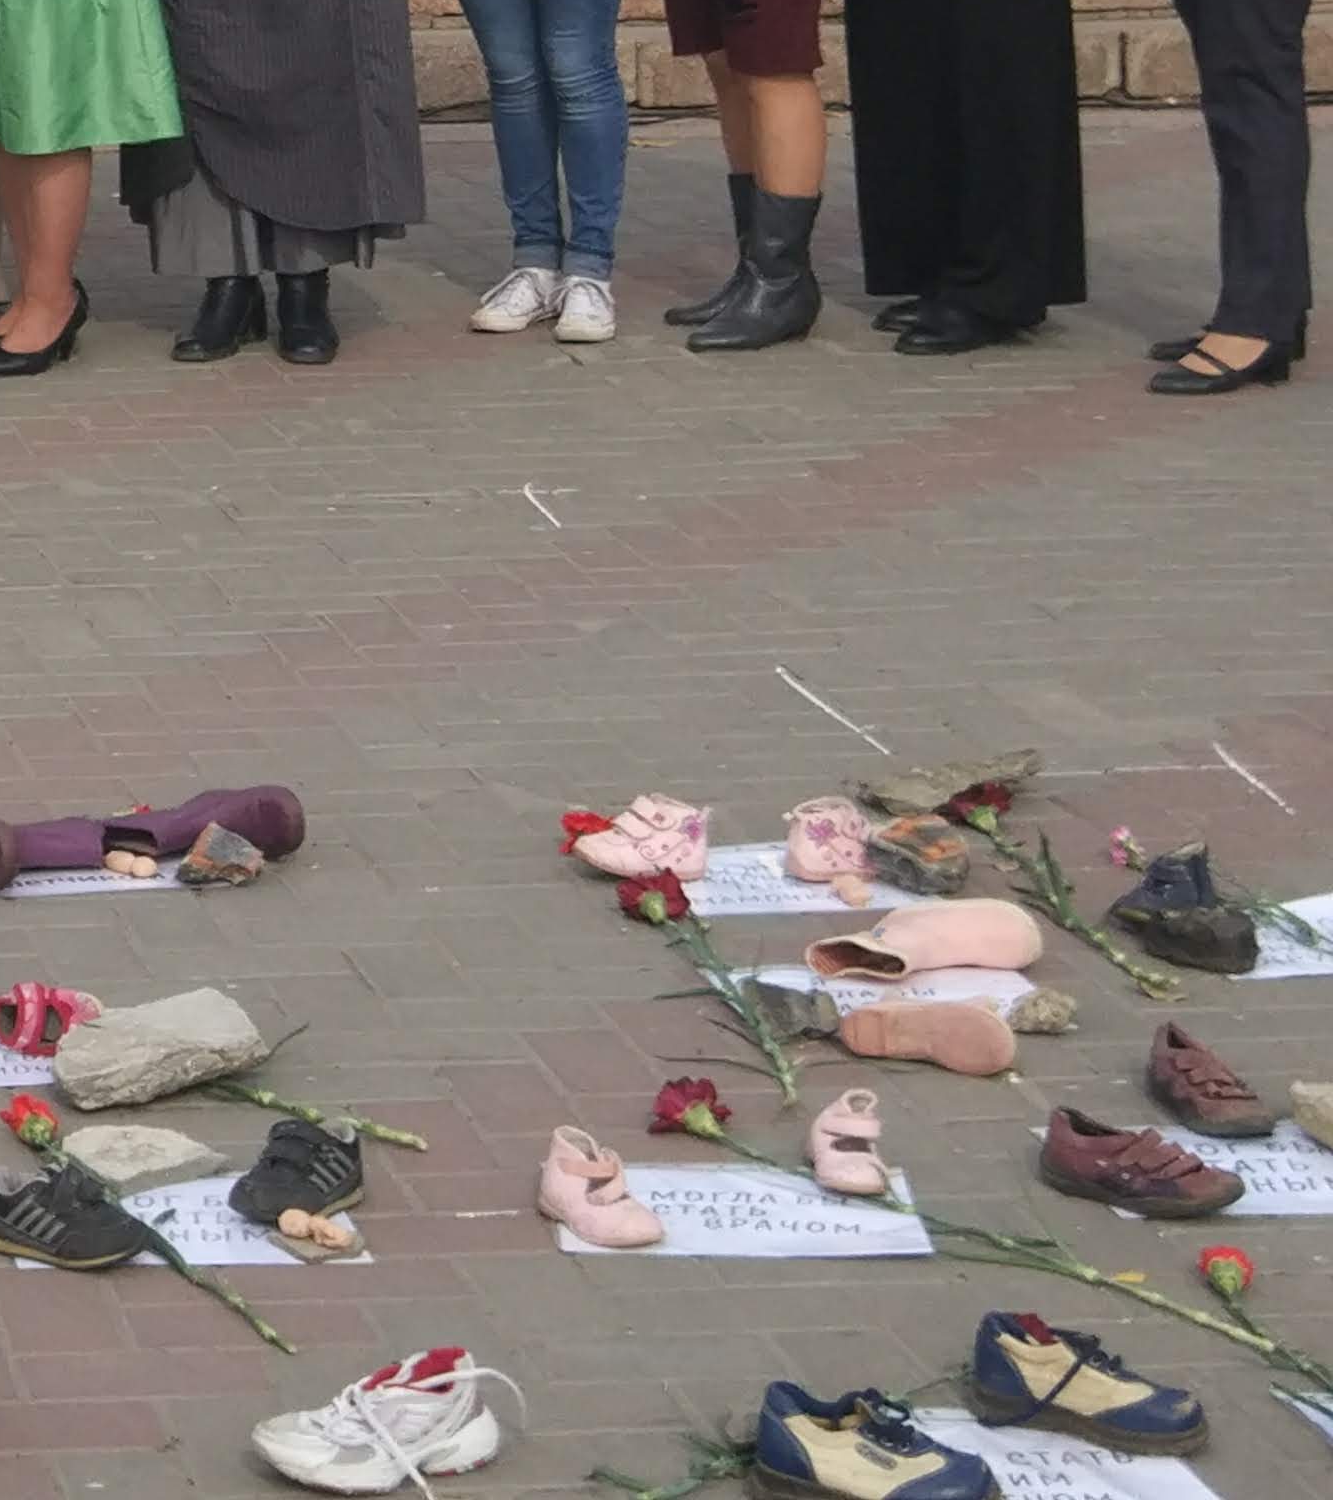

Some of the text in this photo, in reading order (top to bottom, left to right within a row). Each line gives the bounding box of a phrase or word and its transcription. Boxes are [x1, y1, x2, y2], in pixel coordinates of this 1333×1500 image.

[650, 1190, 778, 1205] МОГЛА
[651, 1204, 768, 1217] СТАТЬ
[702, 1218, 862, 1235] ВРАЧОМ
